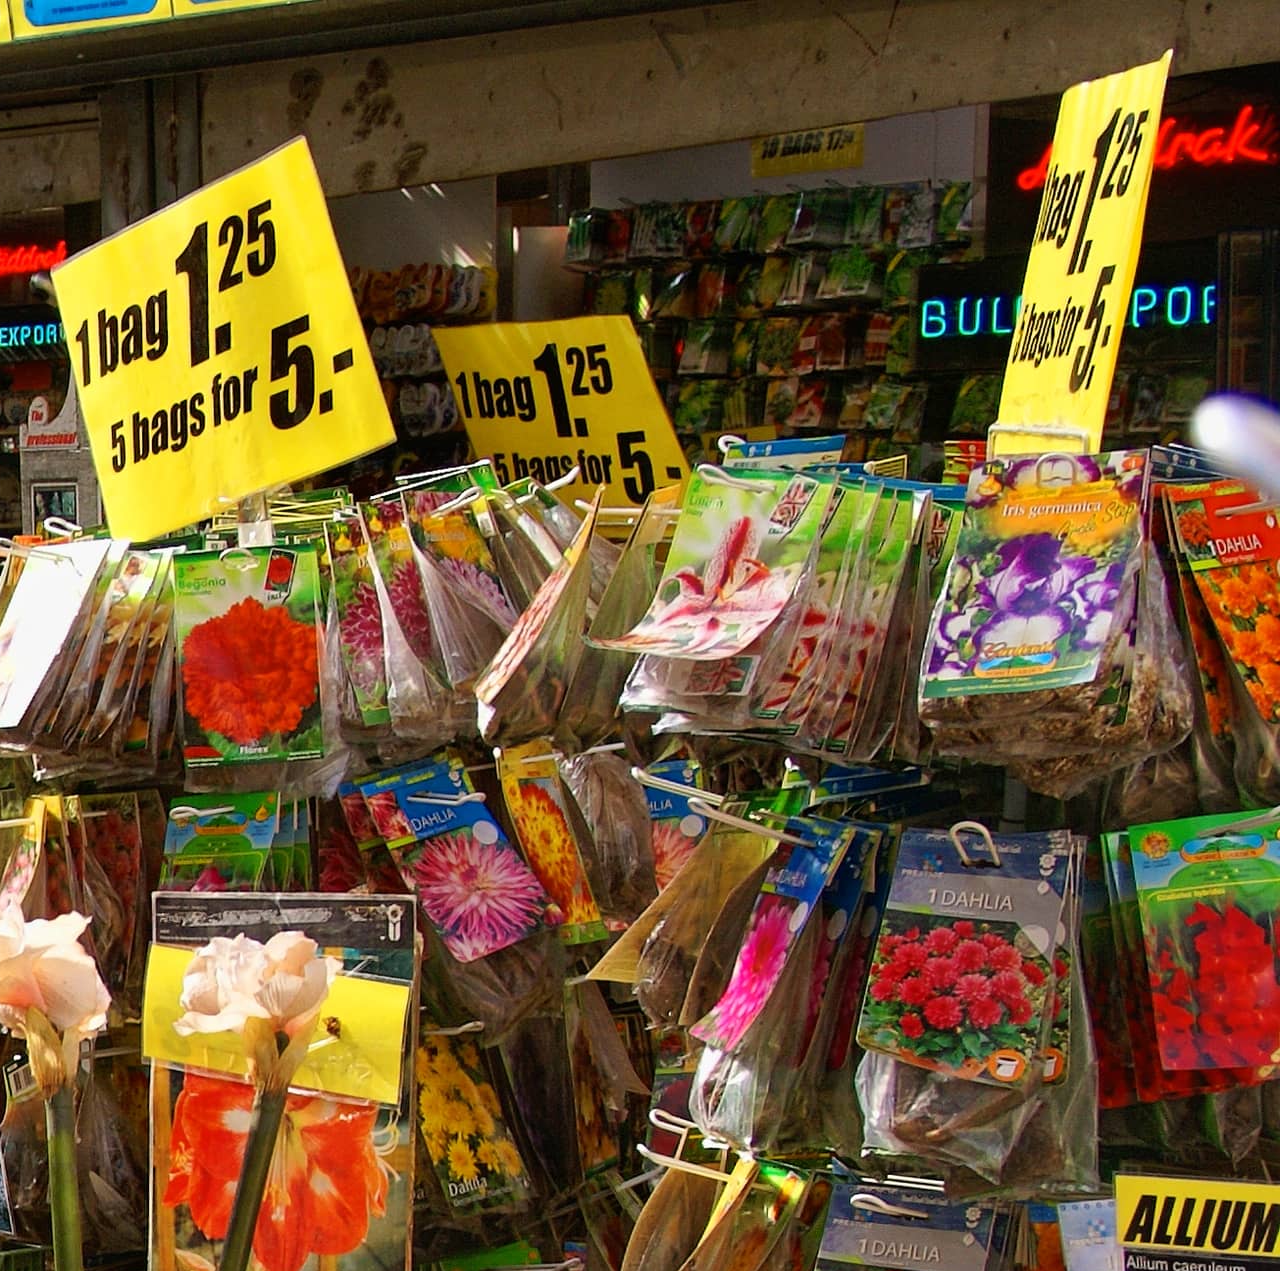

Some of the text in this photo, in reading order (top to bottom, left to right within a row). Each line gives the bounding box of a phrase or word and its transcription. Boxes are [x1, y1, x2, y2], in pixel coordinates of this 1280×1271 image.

[1067, 107, 1149, 276] 1.25
[96, 199, 278, 374] bag 1.25
[132, 314, 355, 465] bags for 5.-
[473, 343, 614, 437] bag 1.25
[1001, 501, 1103, 519] Iris germanica
[1216, 534, 1263, 556] DAHLIA
[411, 808, 457, 833] DAHLIA
[941, 889, 1013, 911] DAHLIA
[448, 1176, 488, 1198] Dahlia
[1124, 1193, 1280, 1253] ALLIUM
[871, 1240, 941, 1263] DAHLIA
